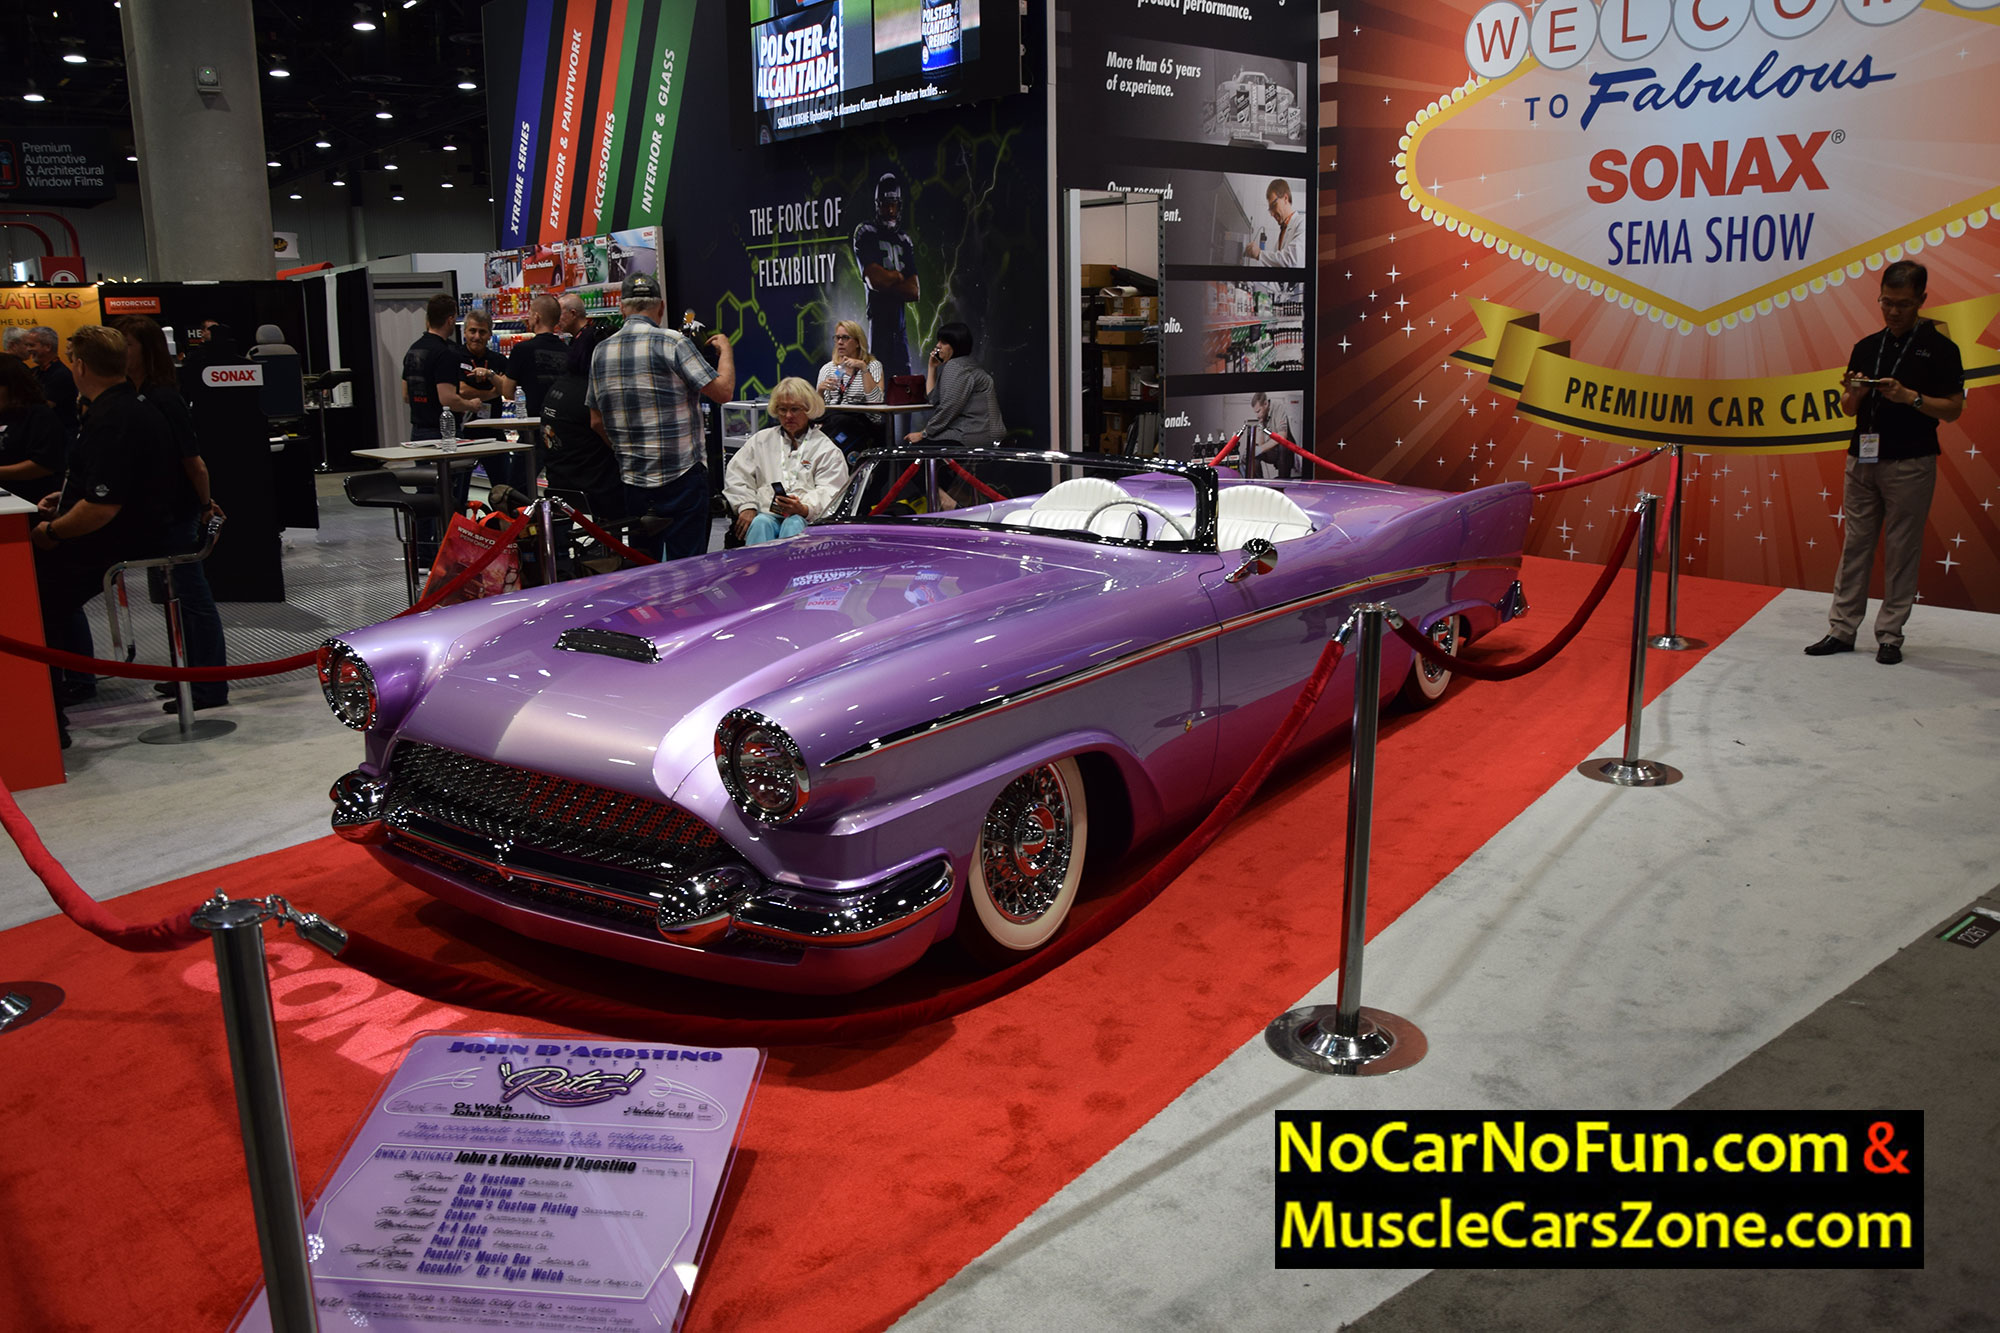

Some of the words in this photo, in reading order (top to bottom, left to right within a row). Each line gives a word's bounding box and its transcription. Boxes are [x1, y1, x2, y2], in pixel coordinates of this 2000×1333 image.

[657, 48, 675, 107] GLASS
[757, 52, 839, 99] ALCANTARA-
[1106, 50, 1133, 70] More
[1135, 54, 1157, 73] than
[1159, 58, 1173, 75] 65
[1175, 61, 1202, 80] years
[560, 28, 583, 133] PAINTWORK
[1106, 73, 1118, 91] of
[1119, 79, 1174, 98] experience.
[1580, 50, 1896, 131] Fabulous
[654, 112, 666, 127] &
[1524, 94, 1568, 121] TO
[21, 142, 72, 153] Premium
[516, 120, 531, 172] SERIES
[559, 136, 569, 150] &
[24, 154, 87, 165] Automotive
[25, 165, 34, 176] &
[36, 164, 104, 176] Architectural
[592, 111, 616, 222] ACCESSORIES
[641, 130, 663, 214] INTERIOR
[26, 176, 71, 187] Window
[74, 176, 104, 187] Films
[549, 152, 567, 230] EXTERIOR
[510, 173, 525, 236] XTREME
[750, 206, 773, 237] THE
[778, 200, 819, 233] FORCE
[824, 196, 842, 228] OF
[1608, 219, 1691, 265] SEMA
[1704, 212, 1814, 262] SHOW
[758, 253, 836, 288] FLEXIBILITY
[17, 318, 39, 326] USA
[211, 370, 256, 383] SONAX
[1564, 376, 1694, 425] PREMIUM
[1707, 396, 1764, 427] CAR
[1780, 388, 1844, 425] CAR
[447, 1041, 528, 1056] JOHN
[534, 1045, 722, 1064] D'AGOSTINO
[453, 1102, 470, 1110] Oz
[474, 1103, 513, 1112] Welch
[454, 1149, 488, 1166] John
[487, 1152, 499, 1166] &
[499, 1152, 560, 1170] Kathleen
[562, 1156, 637, 1174] D'Agostino
[497, 1199, 537, 1214] Custom
[540, 1202, 579, 1219] Plating
[431, 1234, 455, 1248] Paul
[461, 1223, 488, 1236] Auto
[474, 1250, 510, 1266] Music
